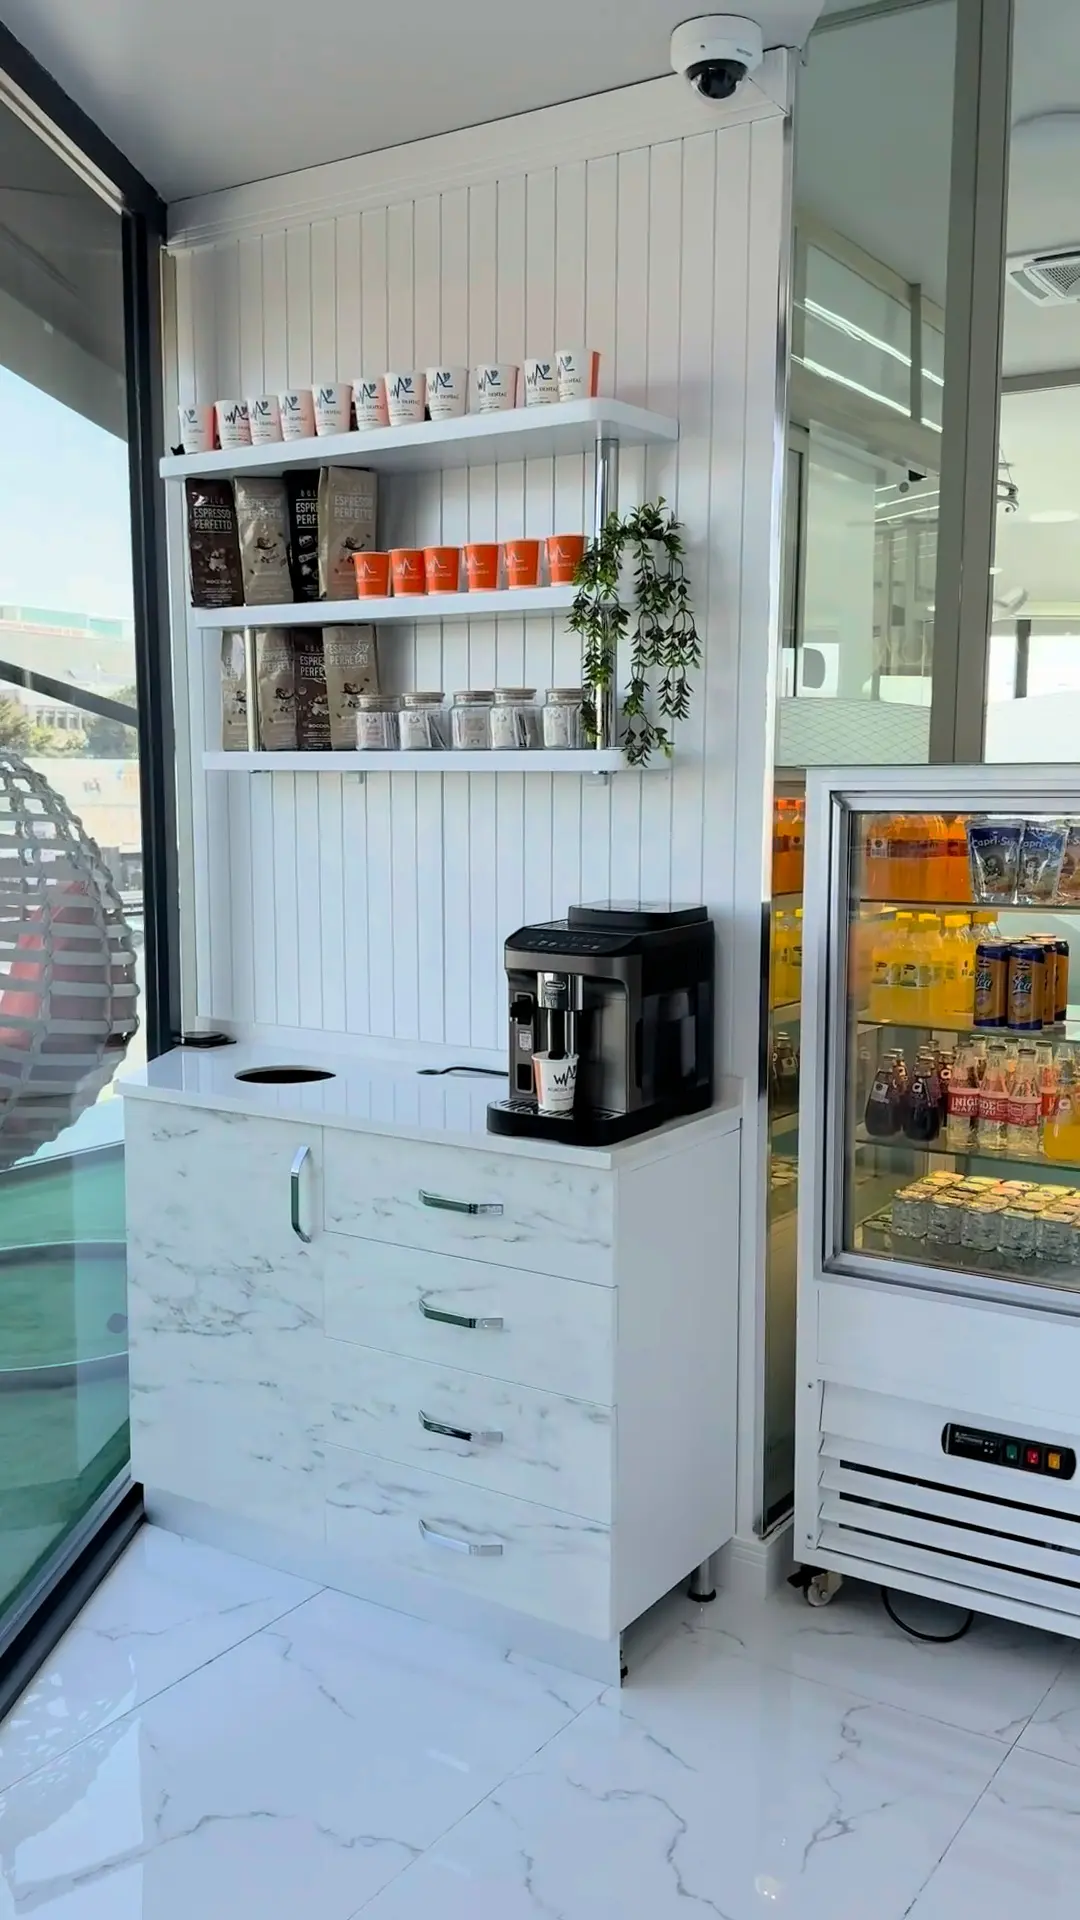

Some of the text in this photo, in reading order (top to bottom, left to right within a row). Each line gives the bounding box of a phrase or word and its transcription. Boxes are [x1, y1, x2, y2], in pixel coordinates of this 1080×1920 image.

[193, 507, 232, 519] ESPRESSO
[194, 519, 232, 530] PERFETTO
[296, 514, 318, 525] PERF
